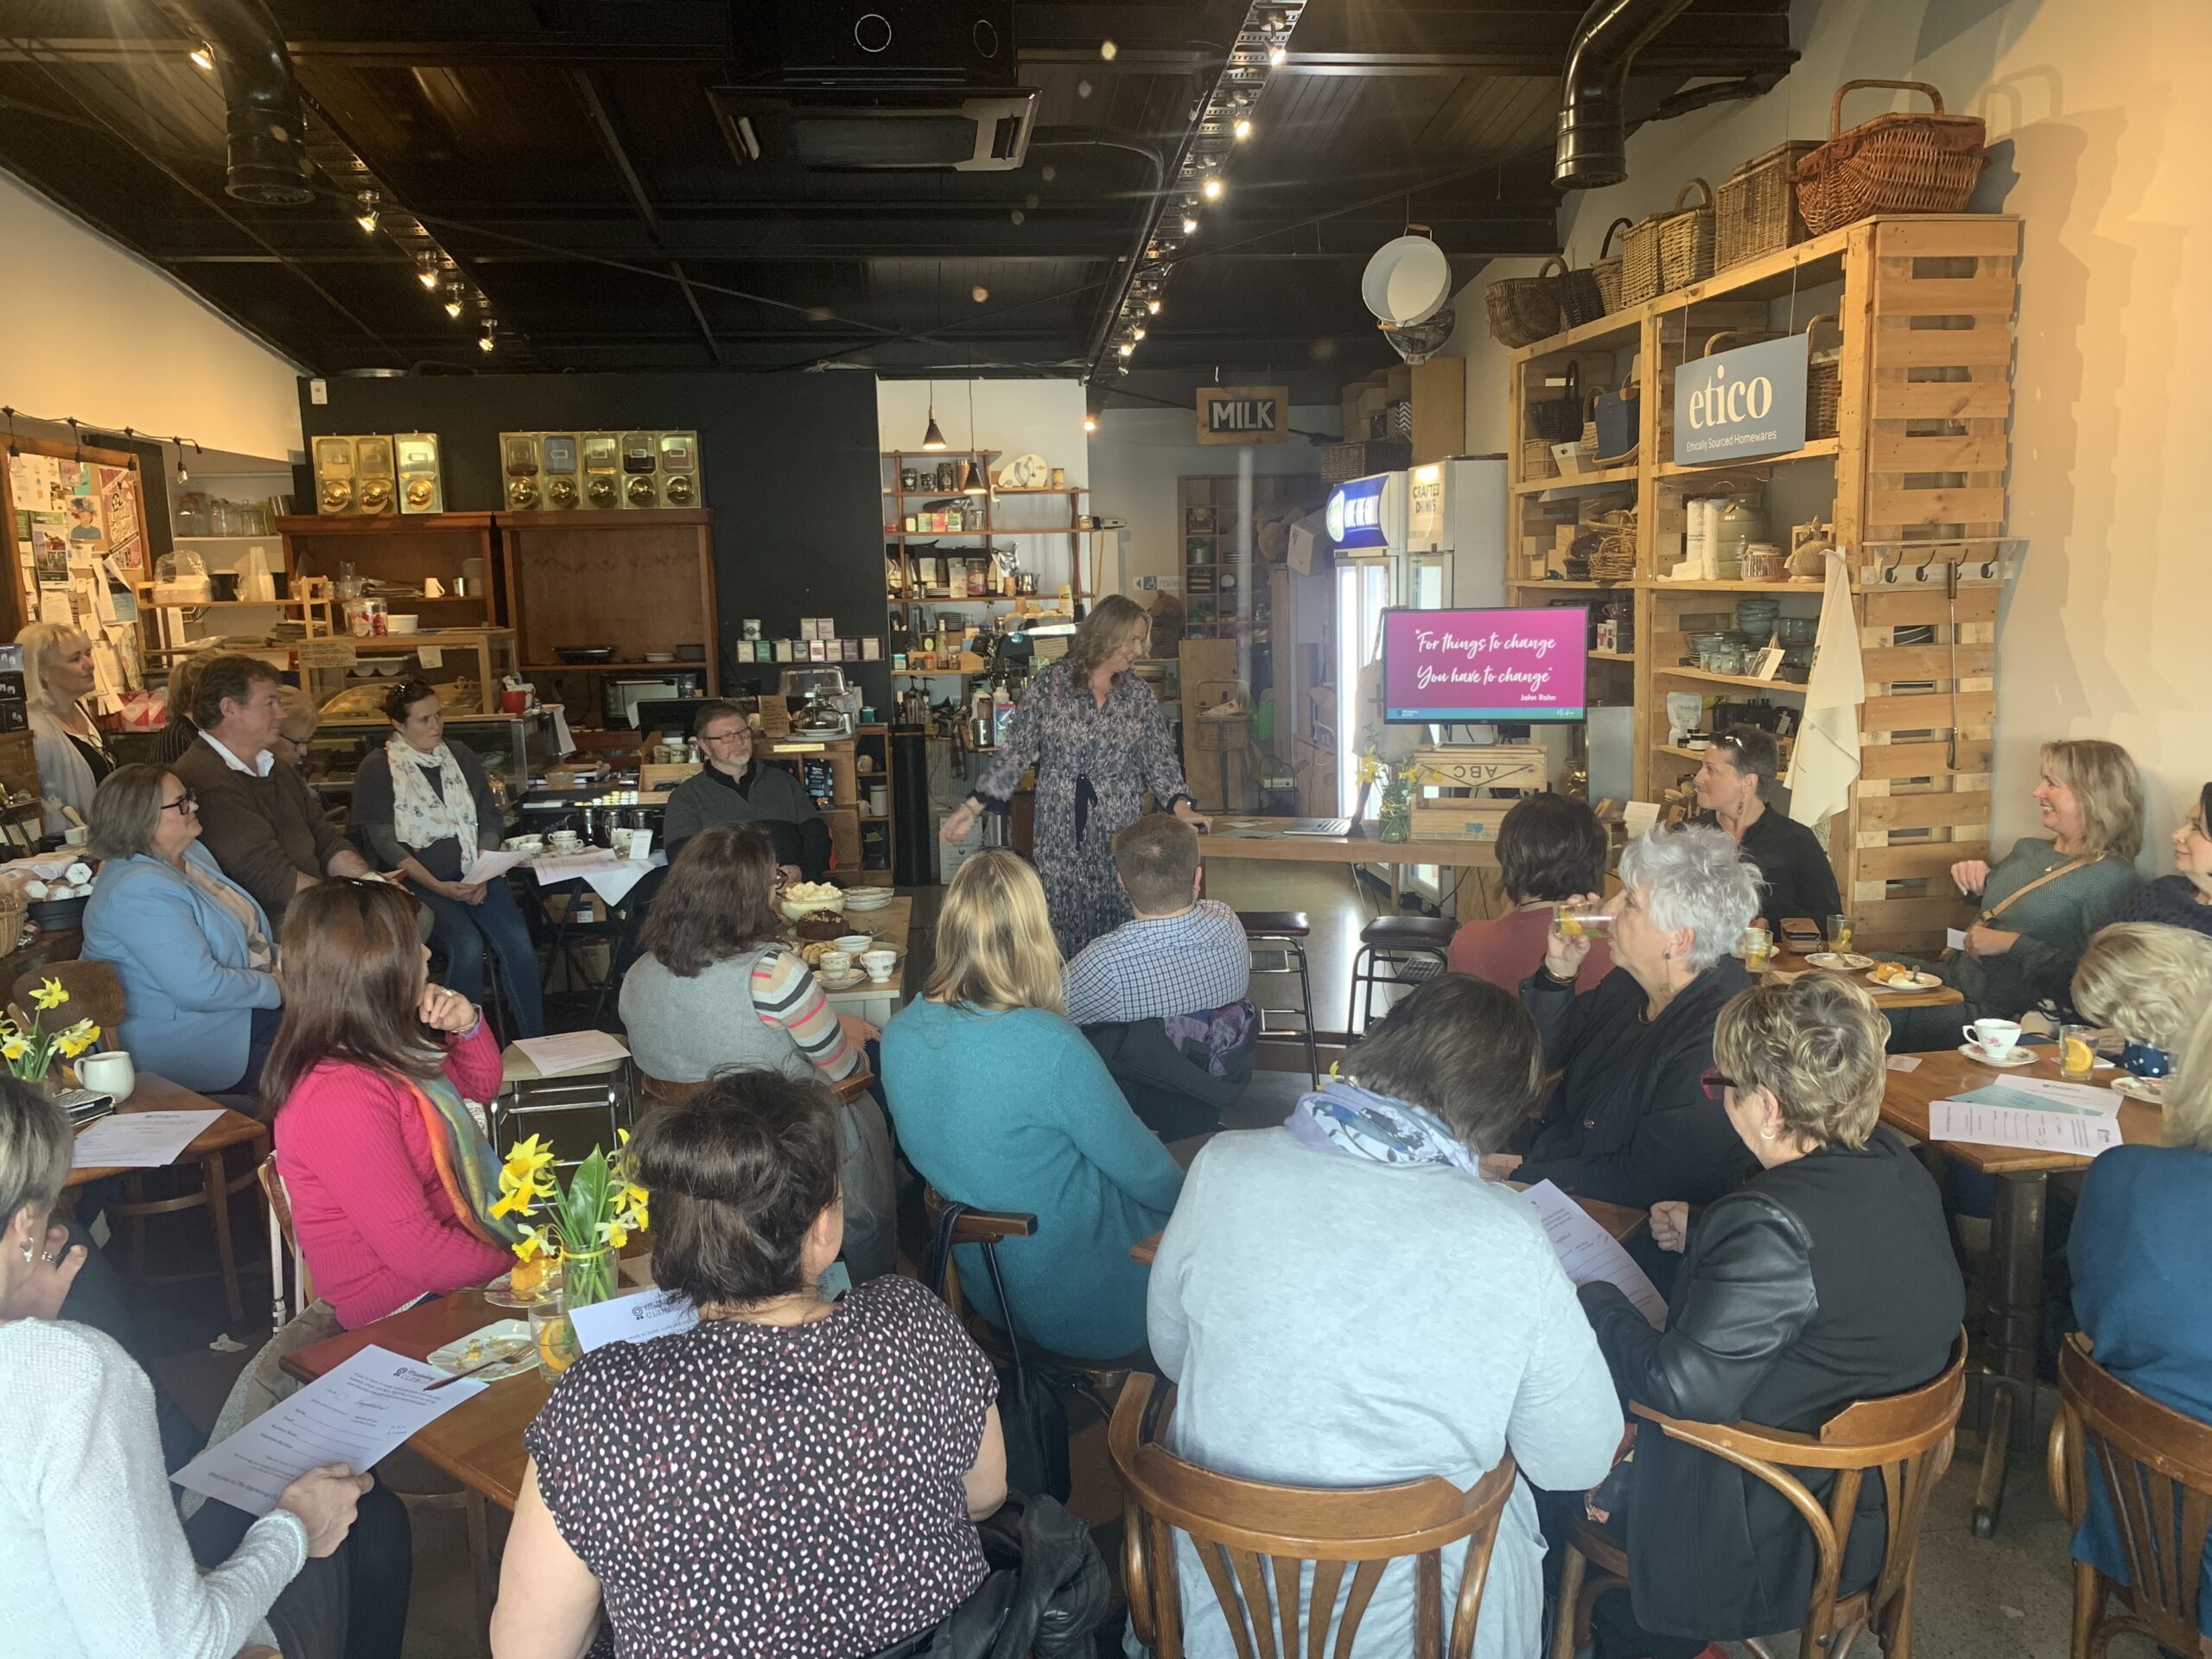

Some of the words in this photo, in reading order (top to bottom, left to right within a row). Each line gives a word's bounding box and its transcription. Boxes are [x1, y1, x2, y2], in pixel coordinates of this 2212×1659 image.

[1689, 365, 1772, 429] etico
[1212, 400, 1274, 429] MILK
[1687, 439, 1708, 453] Ethically
[1708, 434, 1734, 448] Sourced
[1734, 429, 1777, 444] Homewares
[1412, 482, 1440, 499] CRAFTED
[1441, 632, 1486, 659] things
[1489, 632, 1503, 653] to
[1503, 633, 1557, 658] change
[1417, 665, 1450, 690] You
[1451, 667, 1482, 683] have
[1483, 665, 1498, 685] to
[1453, 765, 1498, 779] ABC
